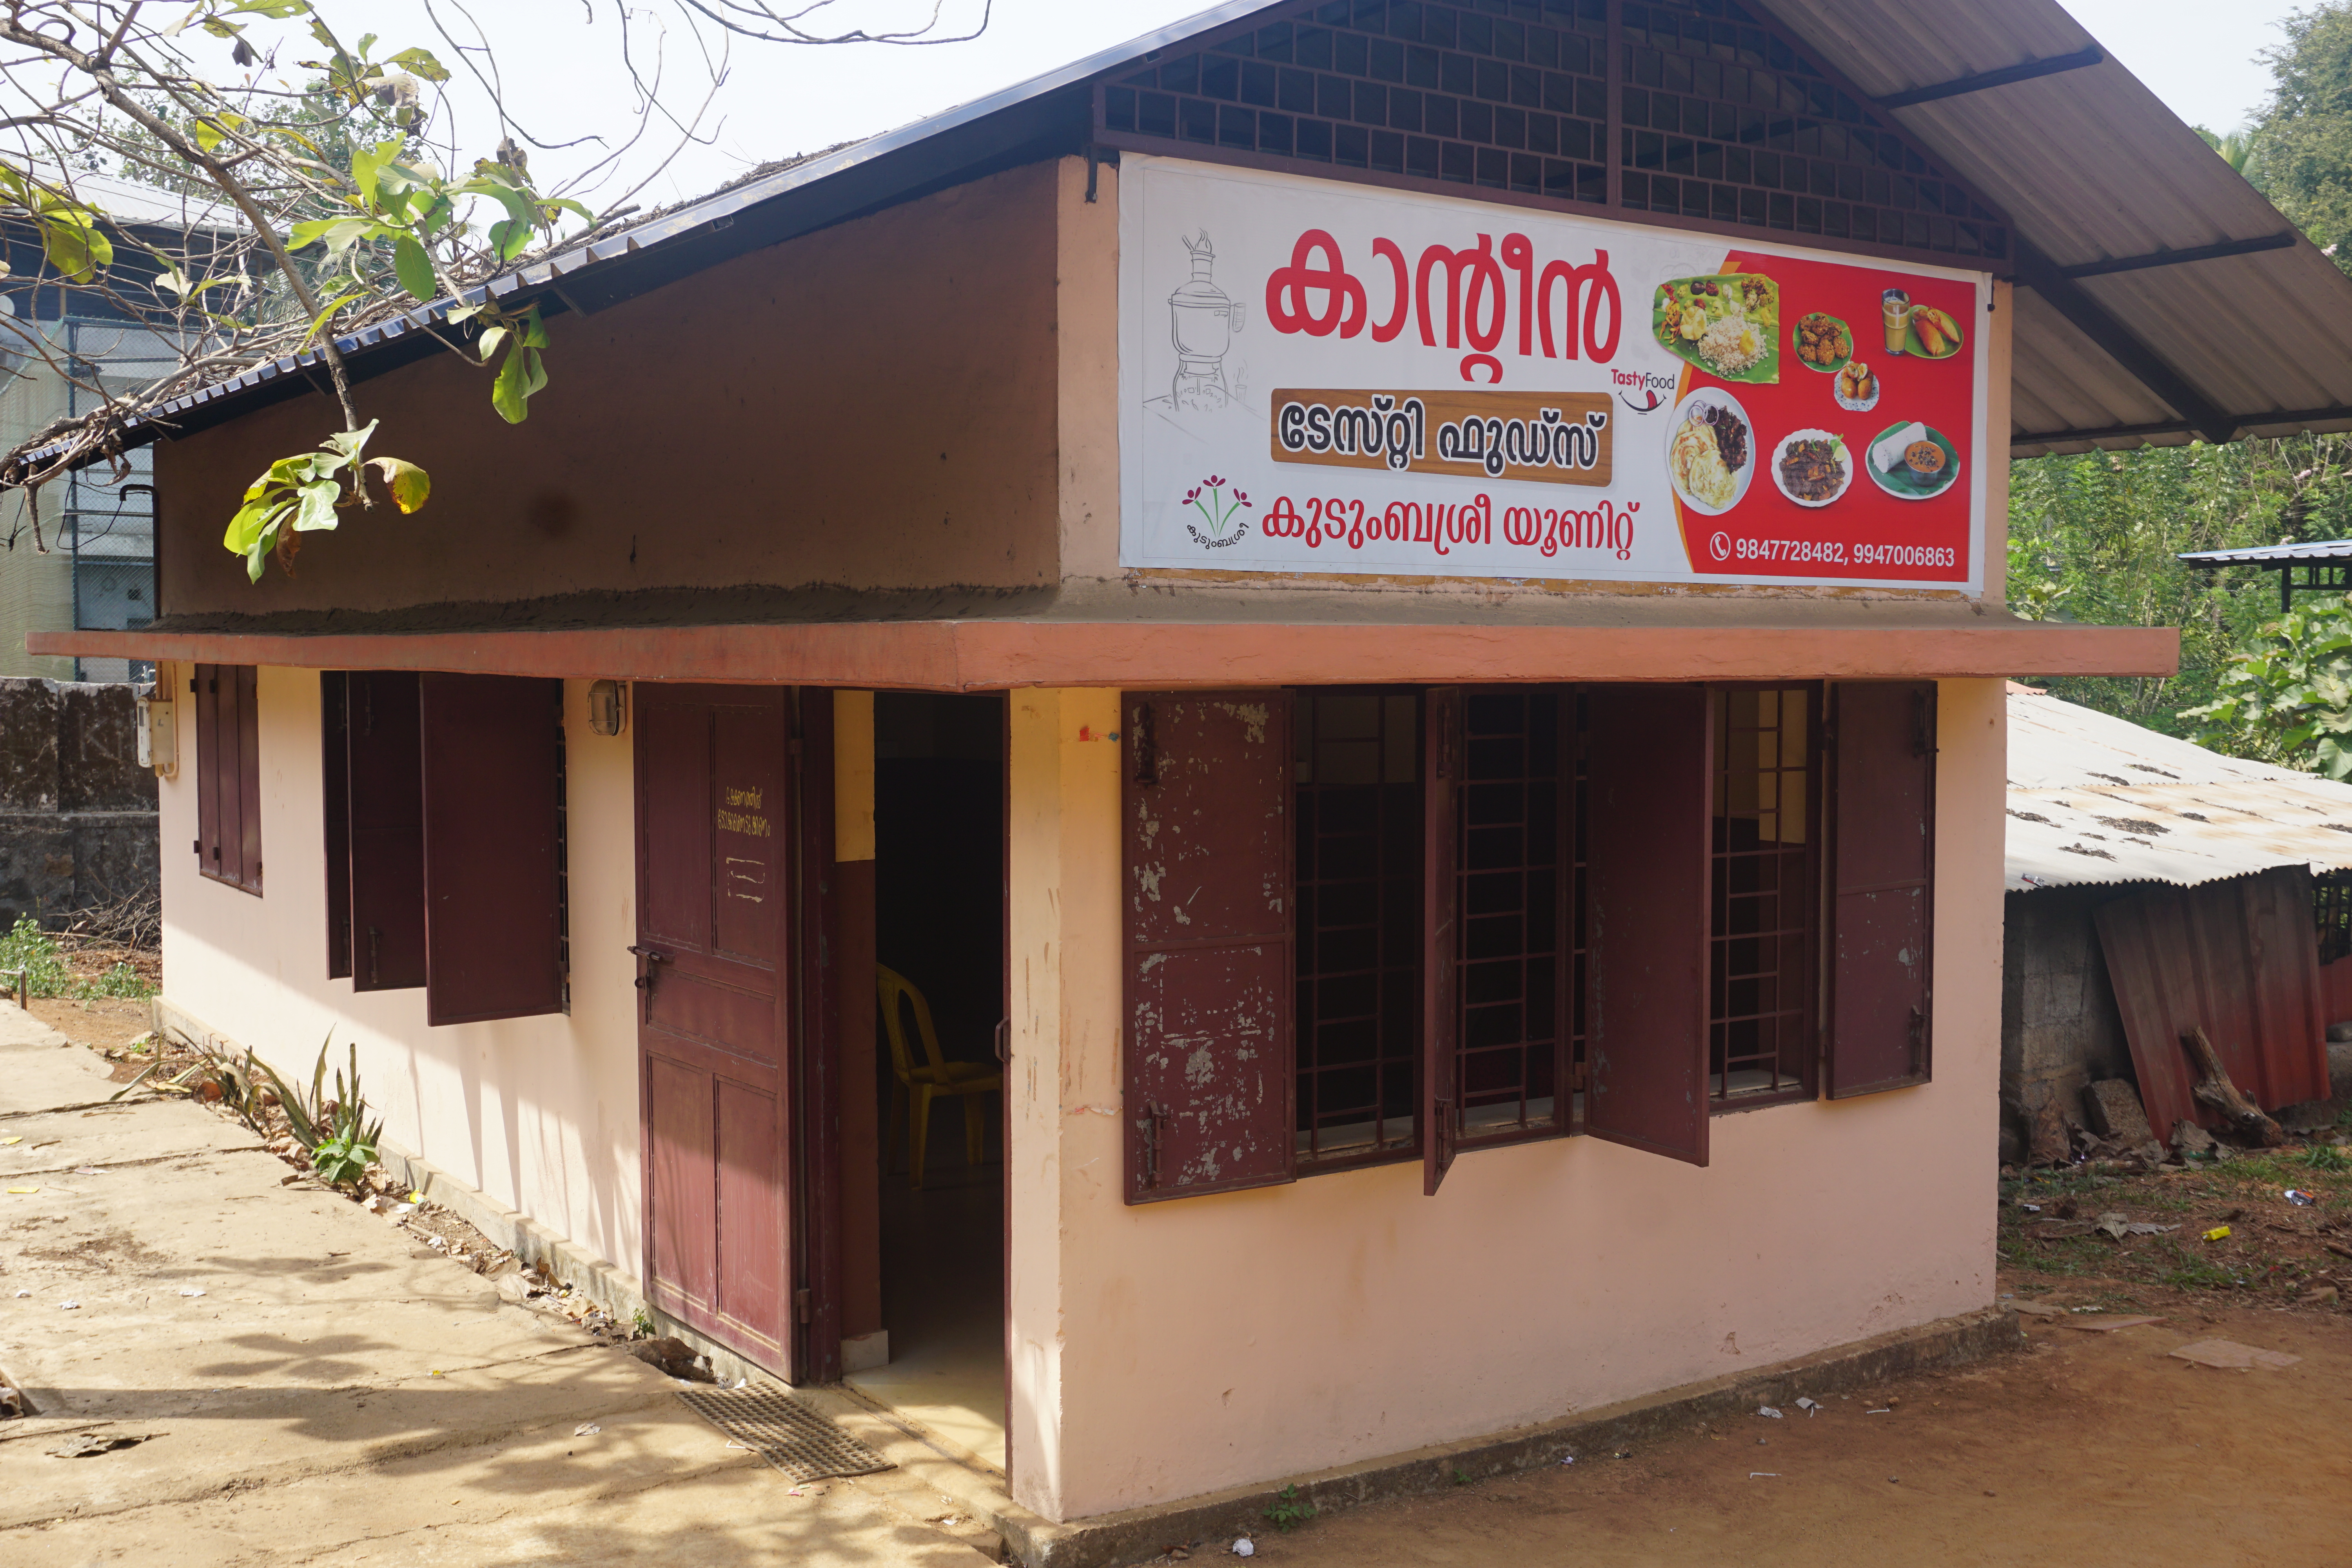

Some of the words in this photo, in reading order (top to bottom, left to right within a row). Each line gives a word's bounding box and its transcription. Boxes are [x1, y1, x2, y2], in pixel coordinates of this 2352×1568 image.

[1280, 397, 1423, 469] ടേസ്റ്റി
[1187, 523, 1249, 550] കുടുംബശ്രീ
[1262, 494, 1491, 555] കുടുംബശ്രീ
[1503, 500, 1640, 560] യൂണിറ്റ്
[1736, 538, 1848, 566] 9847728482,
[1854, 544, 1954, 567] 9947006863
